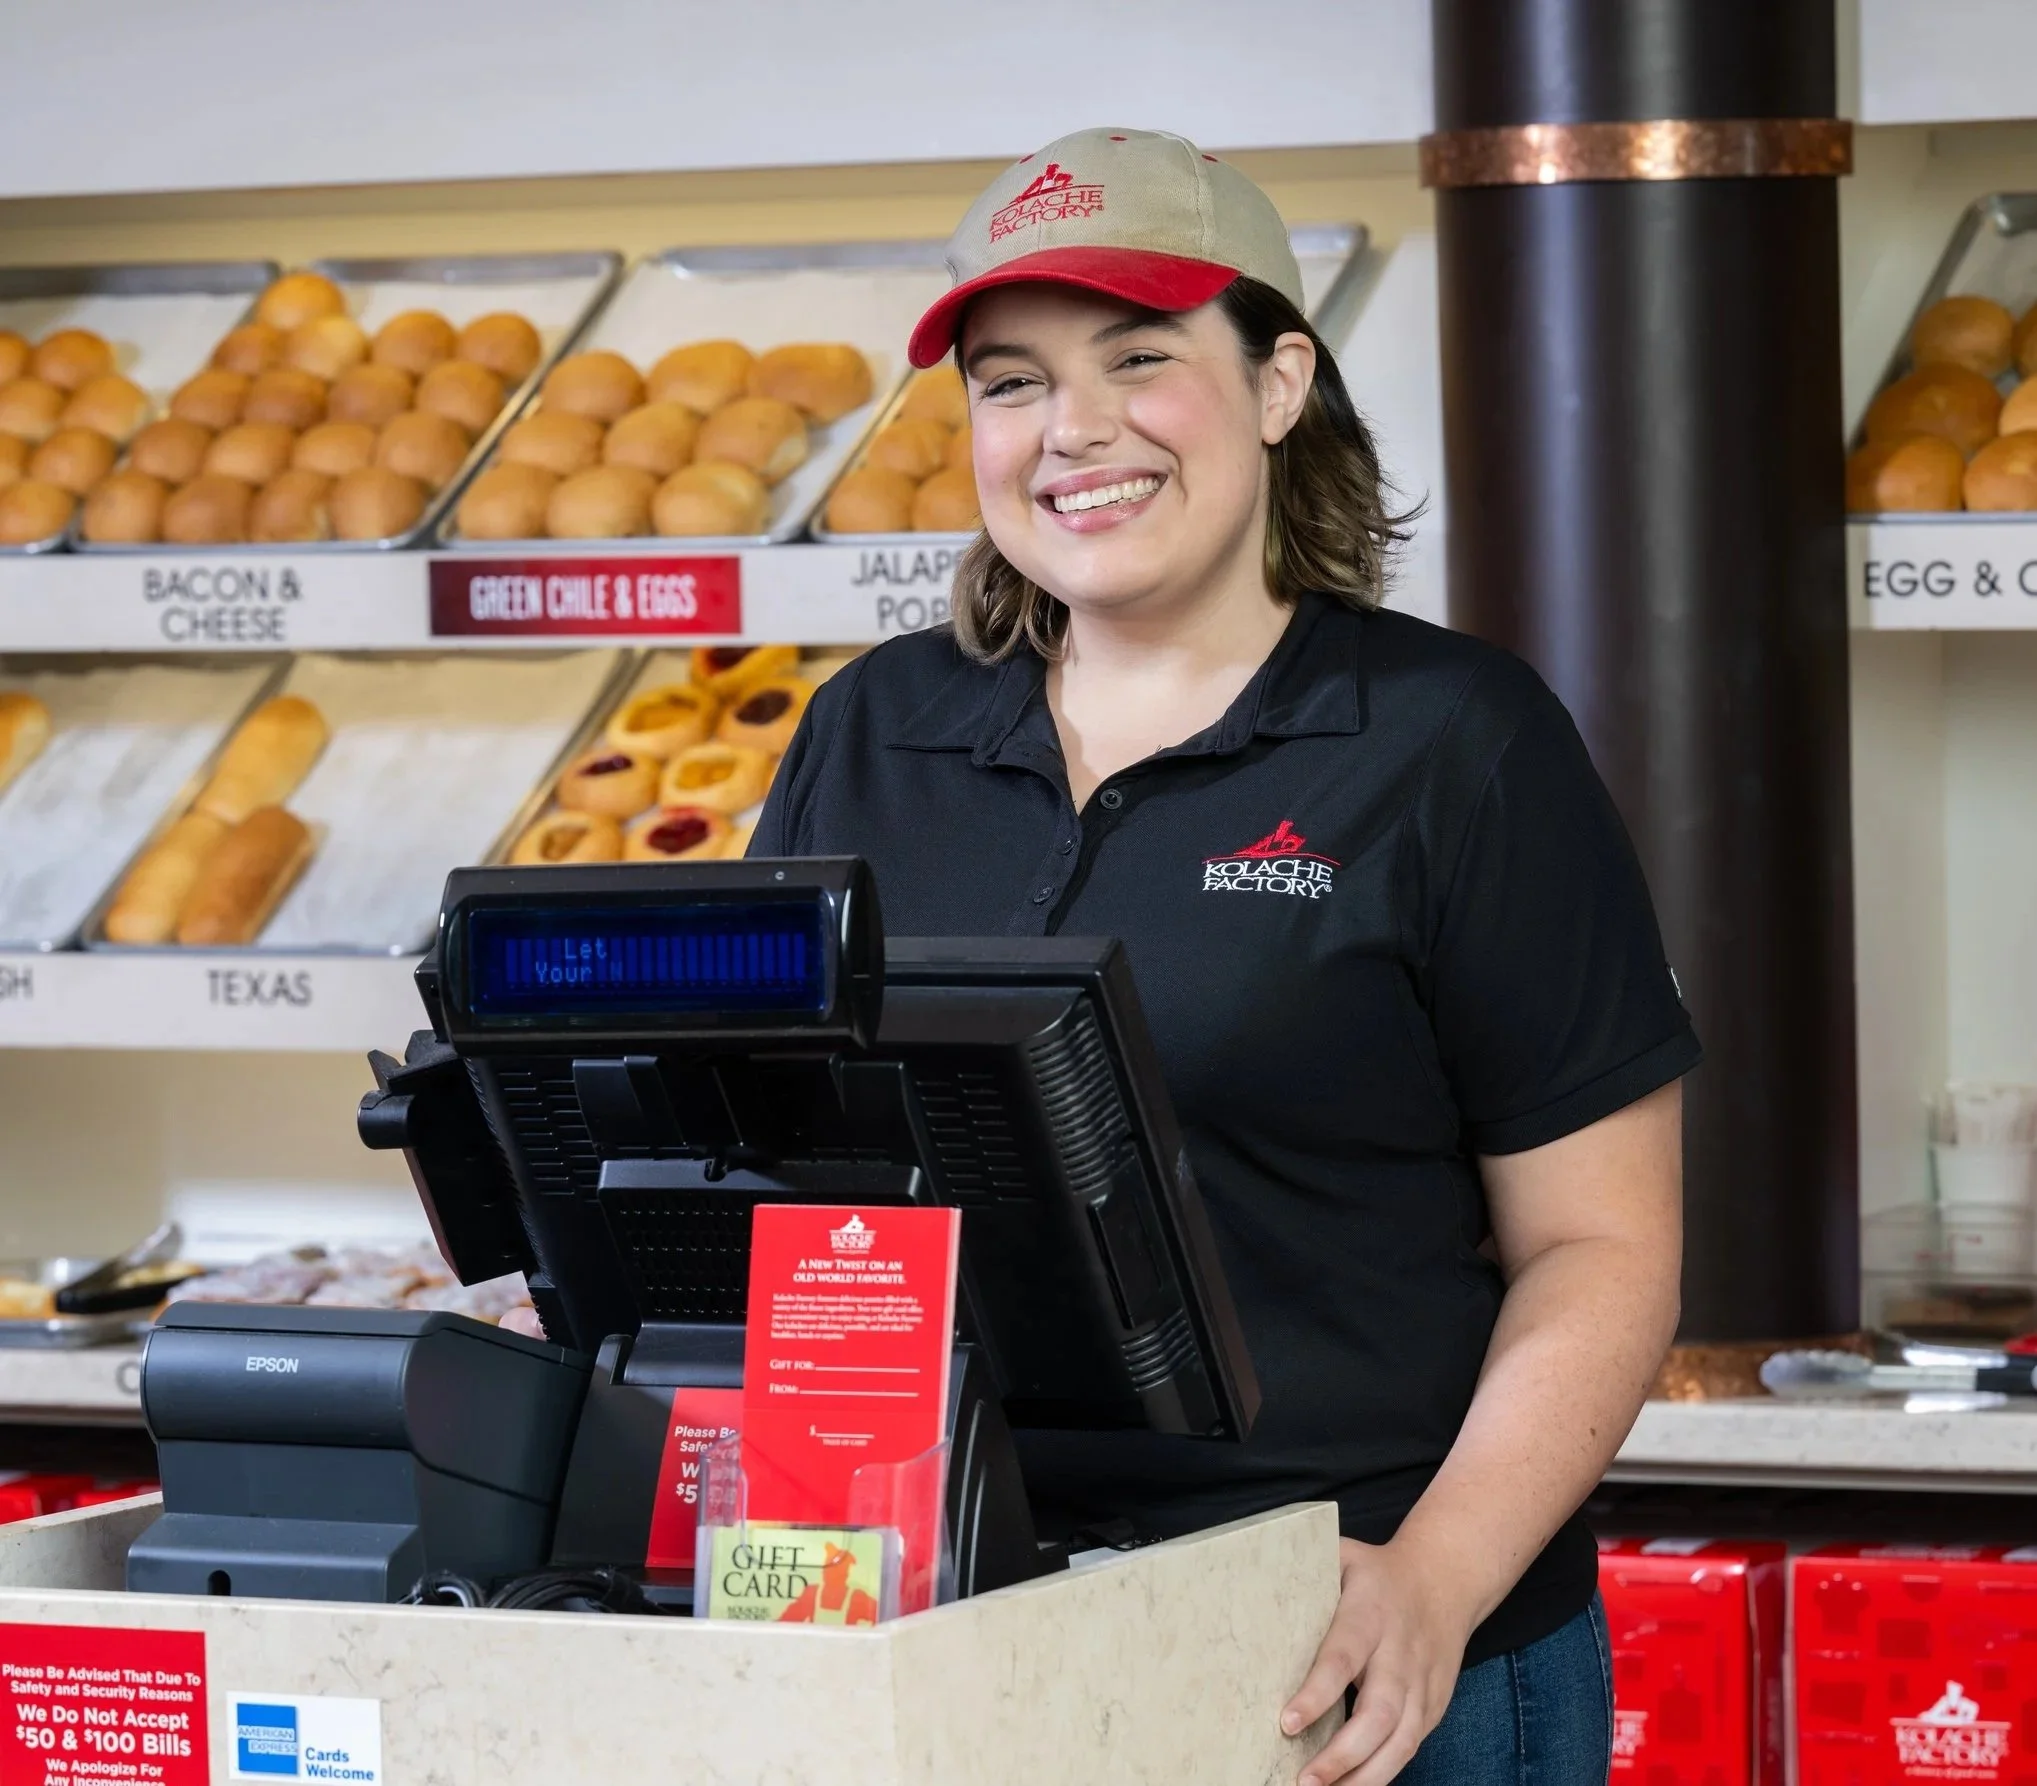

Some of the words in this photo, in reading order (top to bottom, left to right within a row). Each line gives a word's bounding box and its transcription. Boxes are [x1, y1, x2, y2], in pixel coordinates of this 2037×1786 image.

[989, 190, 1103, 232] KOLACHE
[143, 566, 270, 602] BACON
[278, 566, 303, 601] &
[1865, 560, 1955, 597] EGG
[1974, 560, 2003, 597] &
[470, 575, 542, 620] GREEN
[546, 575, 611, 619] CHILE
[614, 574, 634, 619] &
[638, 574, 697, 619] EGGS
[160, 606, 285, 642] CHEESE
[1203, 860, 1333, 883] KOLACHE
[565, 937, 607, 959] Let
[536, 961, 592, 982] Your
[207, 968, 313, 1007] TEXAS
[798, 1259, 807, 1270] A
[868, 1260, 886, 1271] ON
[887, 1261, 903, 1271] AN
[793, 1273, 816, 1283] OLD
[817, 1273, 855, 1283] WORLD
[246, 1357, 299, 1373] EPSON
[675, 1425, 716, 1438] Please
[732, 1544, 805, 1572] GIFT
[723, 1571, 808, 1598] CARD
[2, 1664, 43, 1678] Please
[47, 1666, 64, 1679] Be
[67, 1667, 120, 1682] Advised
[123, 1670, 153, 1683] That
[155, 1671, 182, 1685] Due
[185, 1672, 201, 1686] To
[11, 1680, 52, 1697] Safety
[55, 1683, 79, 1696] and
[83, 1685, 136, 1701] Security
[139, 1687, 193, 1702] Reasons
[16, 1703, 47, 1722] We
[52, 1705, 79, 1723] Do
[83, 1706, 118, 1726] Not
[123, 1709, 189, 1731] Accept
[16, 1725, 55, 1749] $50
[62, 1729, 78, 1750] &
[84, 1728, 135, 1753] $100
[143, 1733, 191, 1756] Bills
[238, 1726, 293, 1739] AMERICAN
[250, 1741, 297, 1753] EXPRESS
[305, 1747, 349, 1762] Cards
[46, 1758, 67, 1772] We
[71, 1759, 137, 1776] Apologize
[140, 1763, 163, 1777] For
[306, 1763, 374, 1781] Welcome
[44, 1774, 70, 1786] Any
